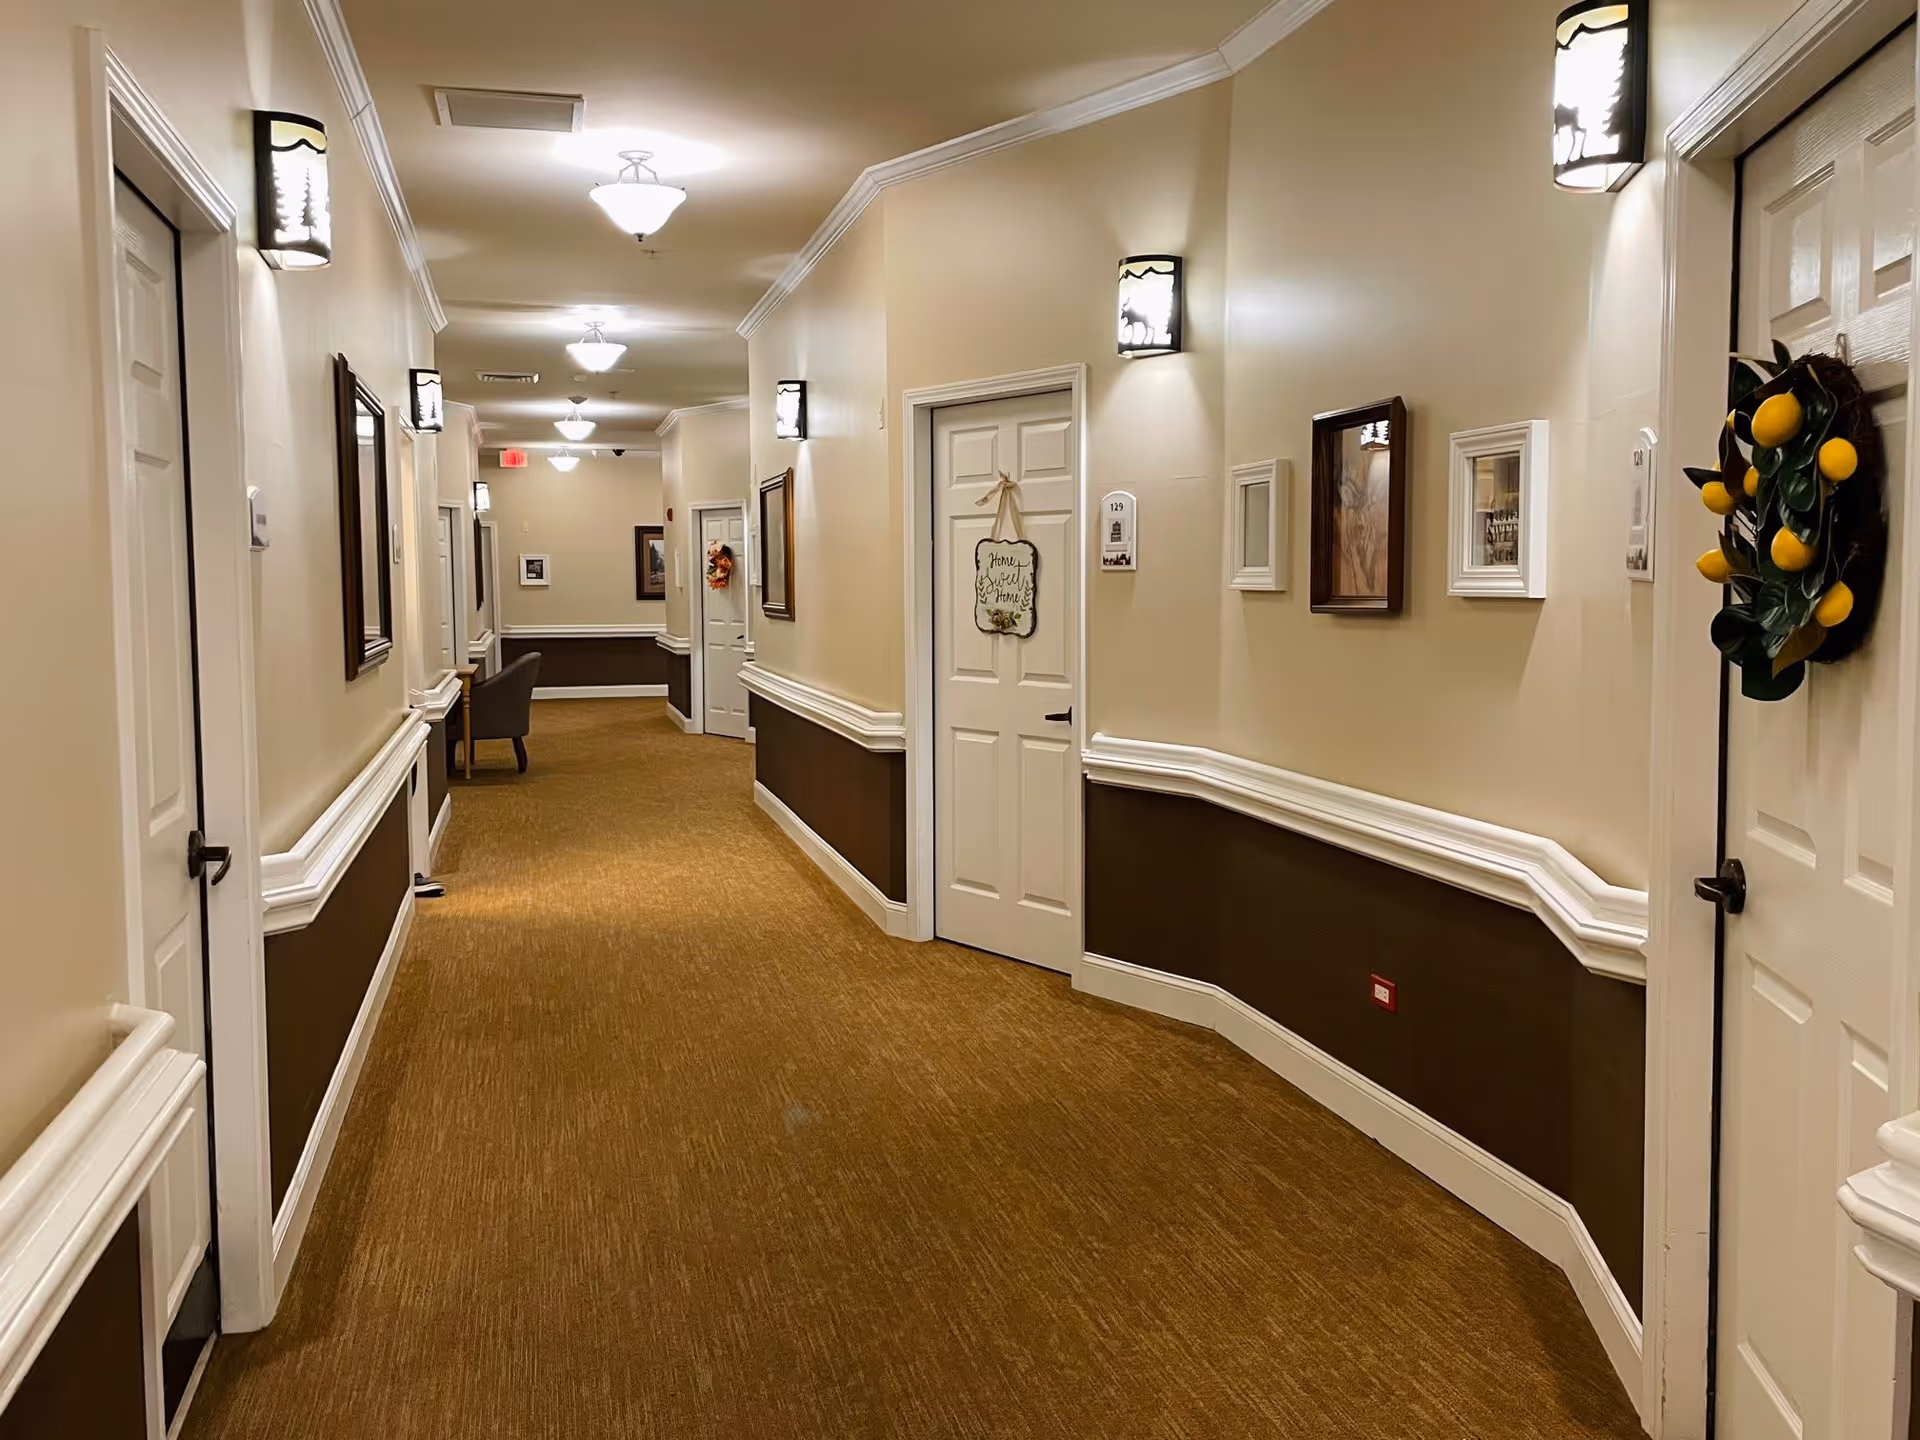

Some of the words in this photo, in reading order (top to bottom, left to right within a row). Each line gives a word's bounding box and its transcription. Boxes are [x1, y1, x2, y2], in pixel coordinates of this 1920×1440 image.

[1110, 502, 1124, 512] 129
[988, 552, 1016, 569] Home
[982, 560, 1030, 595] Sweet
[994, 587, 1021, 604] Home
